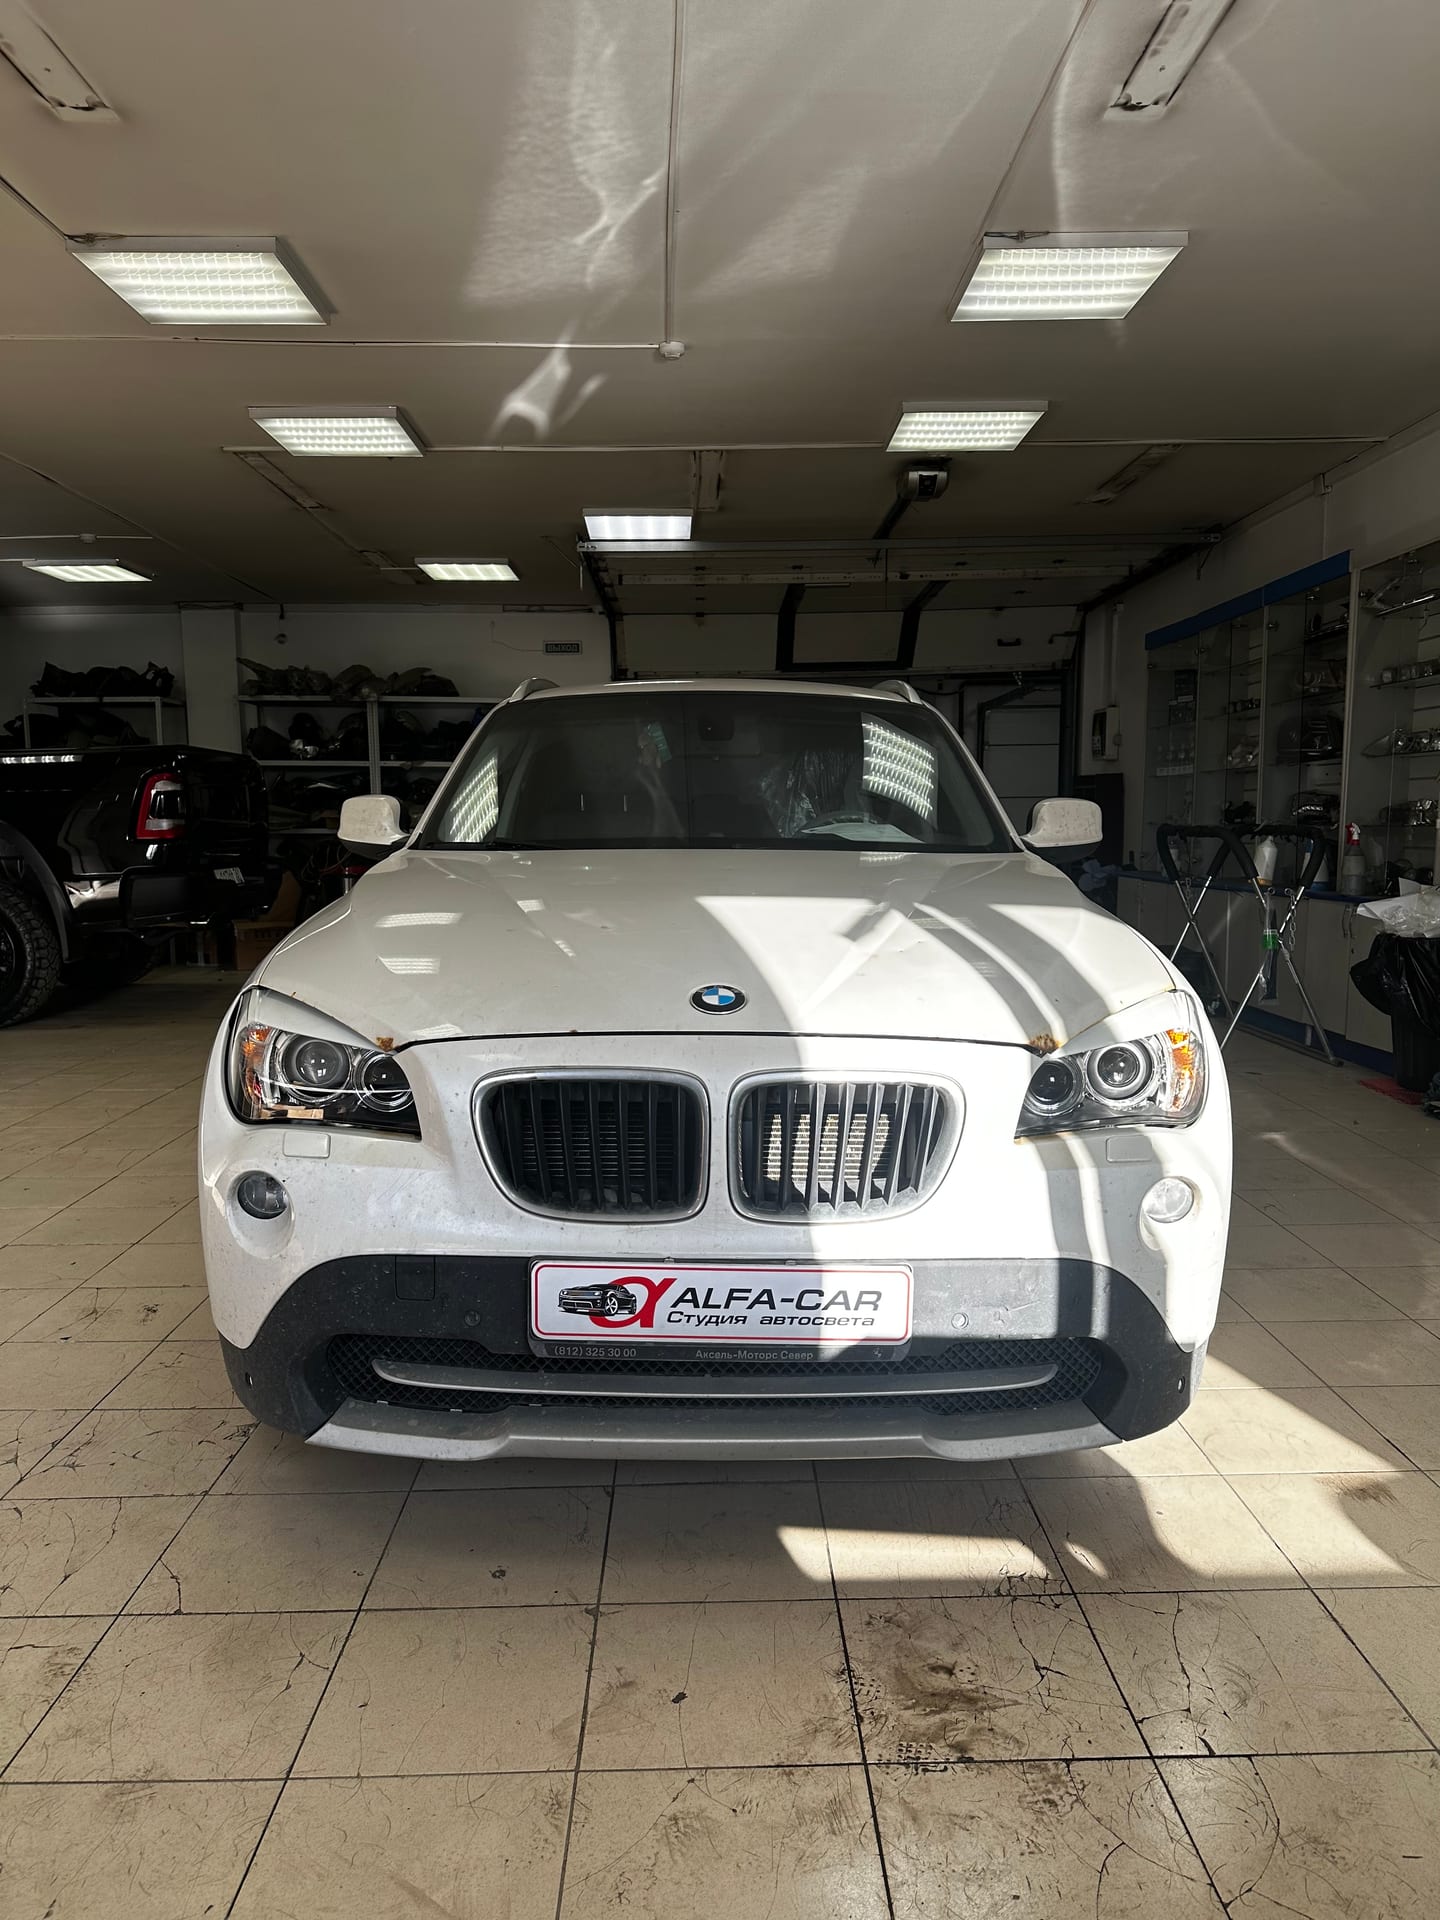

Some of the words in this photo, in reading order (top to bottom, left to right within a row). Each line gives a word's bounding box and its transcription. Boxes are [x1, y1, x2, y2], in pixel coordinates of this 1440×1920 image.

[670, 1287, 882, 1311] ALFA-CAR
[666, 1311, 748, 1327] Студия
[760, 1315, 875, 1326] автосвета
[554, 1346, 583, 1357] (812)
[585, 1347, 605, 1357] 325
[608, 1348, 621, 1357] 30
[623, 1348, 637, 1357] 00
[695, 1349, 778, 1360] Аксель-Моторс
[780, 1350, 814, 1361] Север
